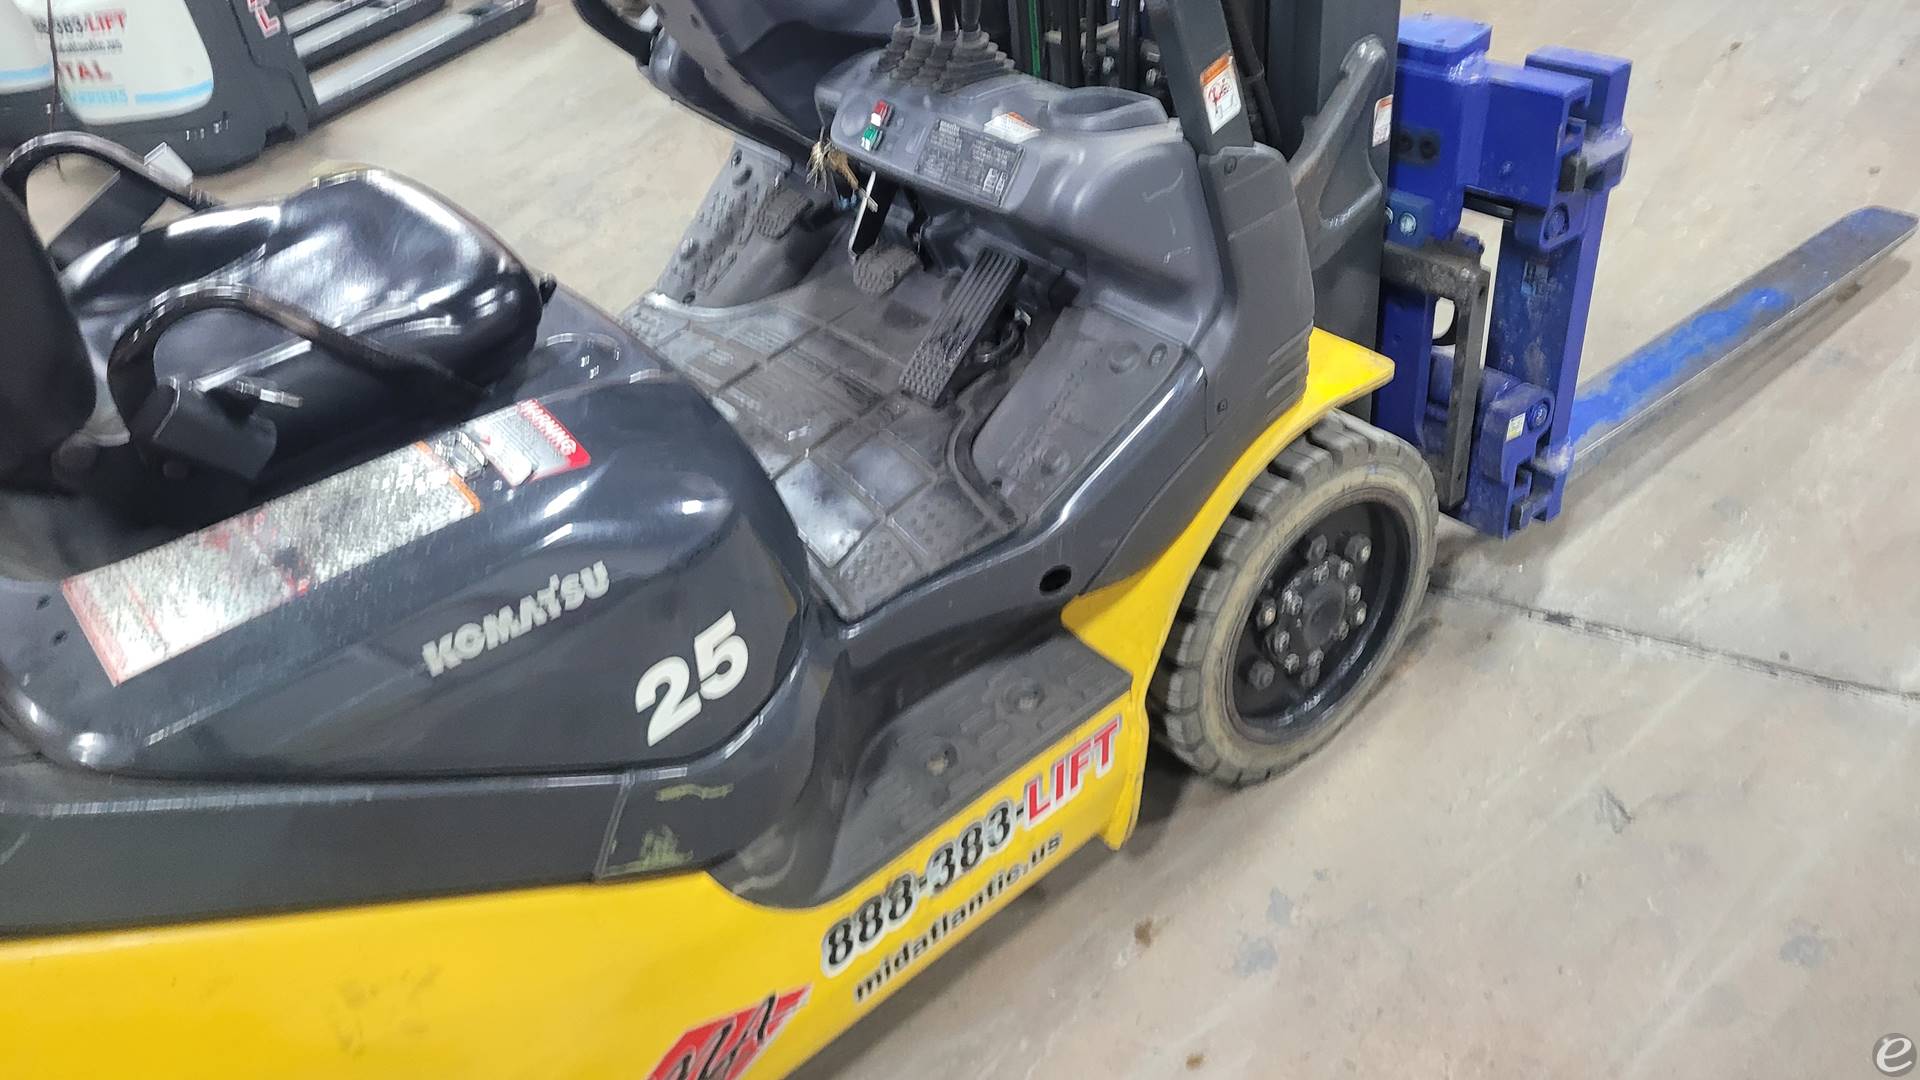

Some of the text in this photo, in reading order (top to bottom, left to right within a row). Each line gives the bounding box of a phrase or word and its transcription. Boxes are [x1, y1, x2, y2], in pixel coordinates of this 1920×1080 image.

[422, 560, 610, 678] KOMATSU
[634, 610, 749, 747] 25
[822, 717, 1121, 974] 888-383-LIFT
[856, 832, 1062, 1001] midatlantic.us
